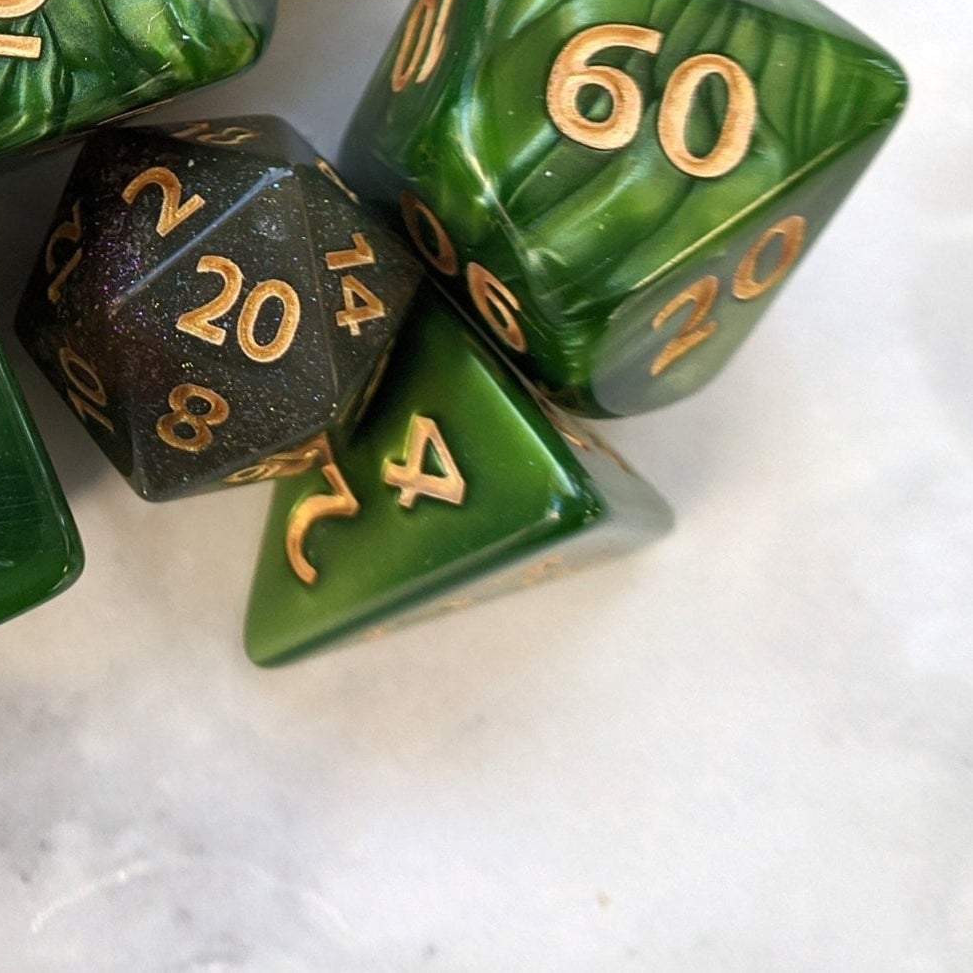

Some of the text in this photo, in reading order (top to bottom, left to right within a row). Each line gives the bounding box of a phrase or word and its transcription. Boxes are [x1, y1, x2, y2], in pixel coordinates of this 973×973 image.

[546, 23, 757, 178] 60
[122, 166, 205, 237] 2
[176, 255, 300, 363] 20
[325, 232, 385, 336] 14
[650, 216, 806, 377] 20
[156, 383, 230, 452] 8
[382, 413, 465, 509] 4
